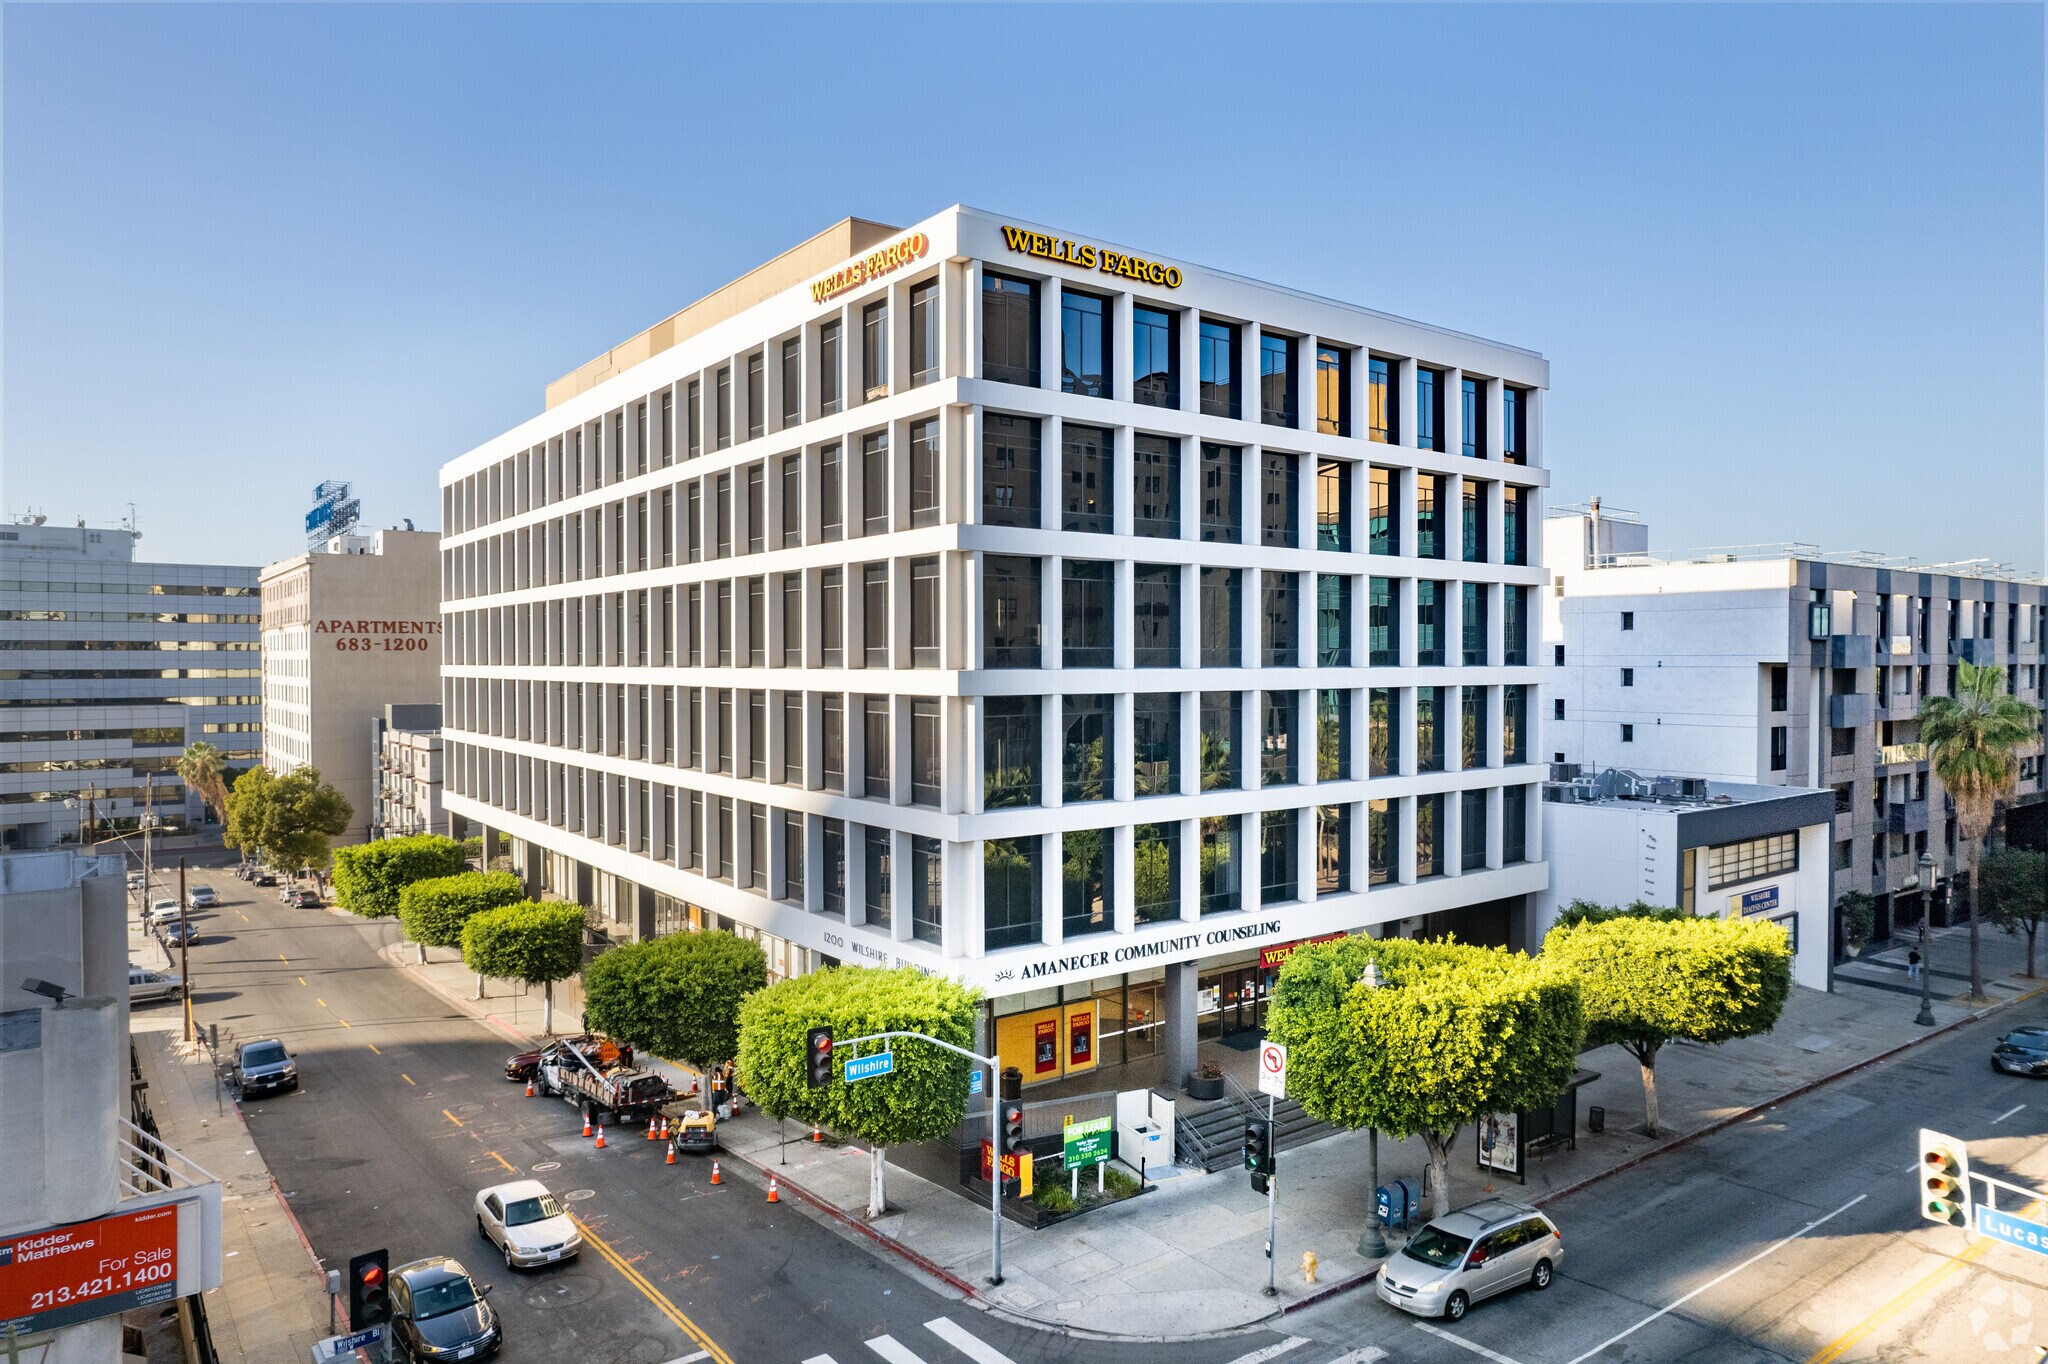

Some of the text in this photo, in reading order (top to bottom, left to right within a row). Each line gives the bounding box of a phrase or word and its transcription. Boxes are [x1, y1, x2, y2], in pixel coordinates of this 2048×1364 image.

[1001, 225, 1182, 288] WELLS FARGO
[810, 231, 929, 304] WELLS FARGO
[337, 638, 428, 651] 683-1200
[824, 931, 844, 948] 1200
[1021, 952, 1109, 980] AMANECER
[1115, 935, 1202, 962] COMMUNITY
[1207, 920, 1281, 945] COUNSELING
[1037, 1022, 1054, 1030] WELLS
[1072, 1015, 1090, 1023] WELLS
[1072, 1020, 1090, 1028] FARGO
[1037, 1027, 1055, 1035] FARGO
[849, 1059, 889, 1077] Wilshire
[1067, 1126, 1083, 1137] FOR
[1085, 1120, 1109, 1133] LEASE
[1068, 1155, 1080, 1163] 310
[135, 1210, 172, 1223] kidder.com
[1985, 1214, 2048, 1250] Lucas
[18, 1232, 74, 1252] Kidder
[18, 1239, 95, 1264] Mathews
[99, 1247, 172, 1274] For Sale
[31, 1262, 172, 1309] 213.421.1400
[337, 1328, 380, 1349] Wilshire Bl
